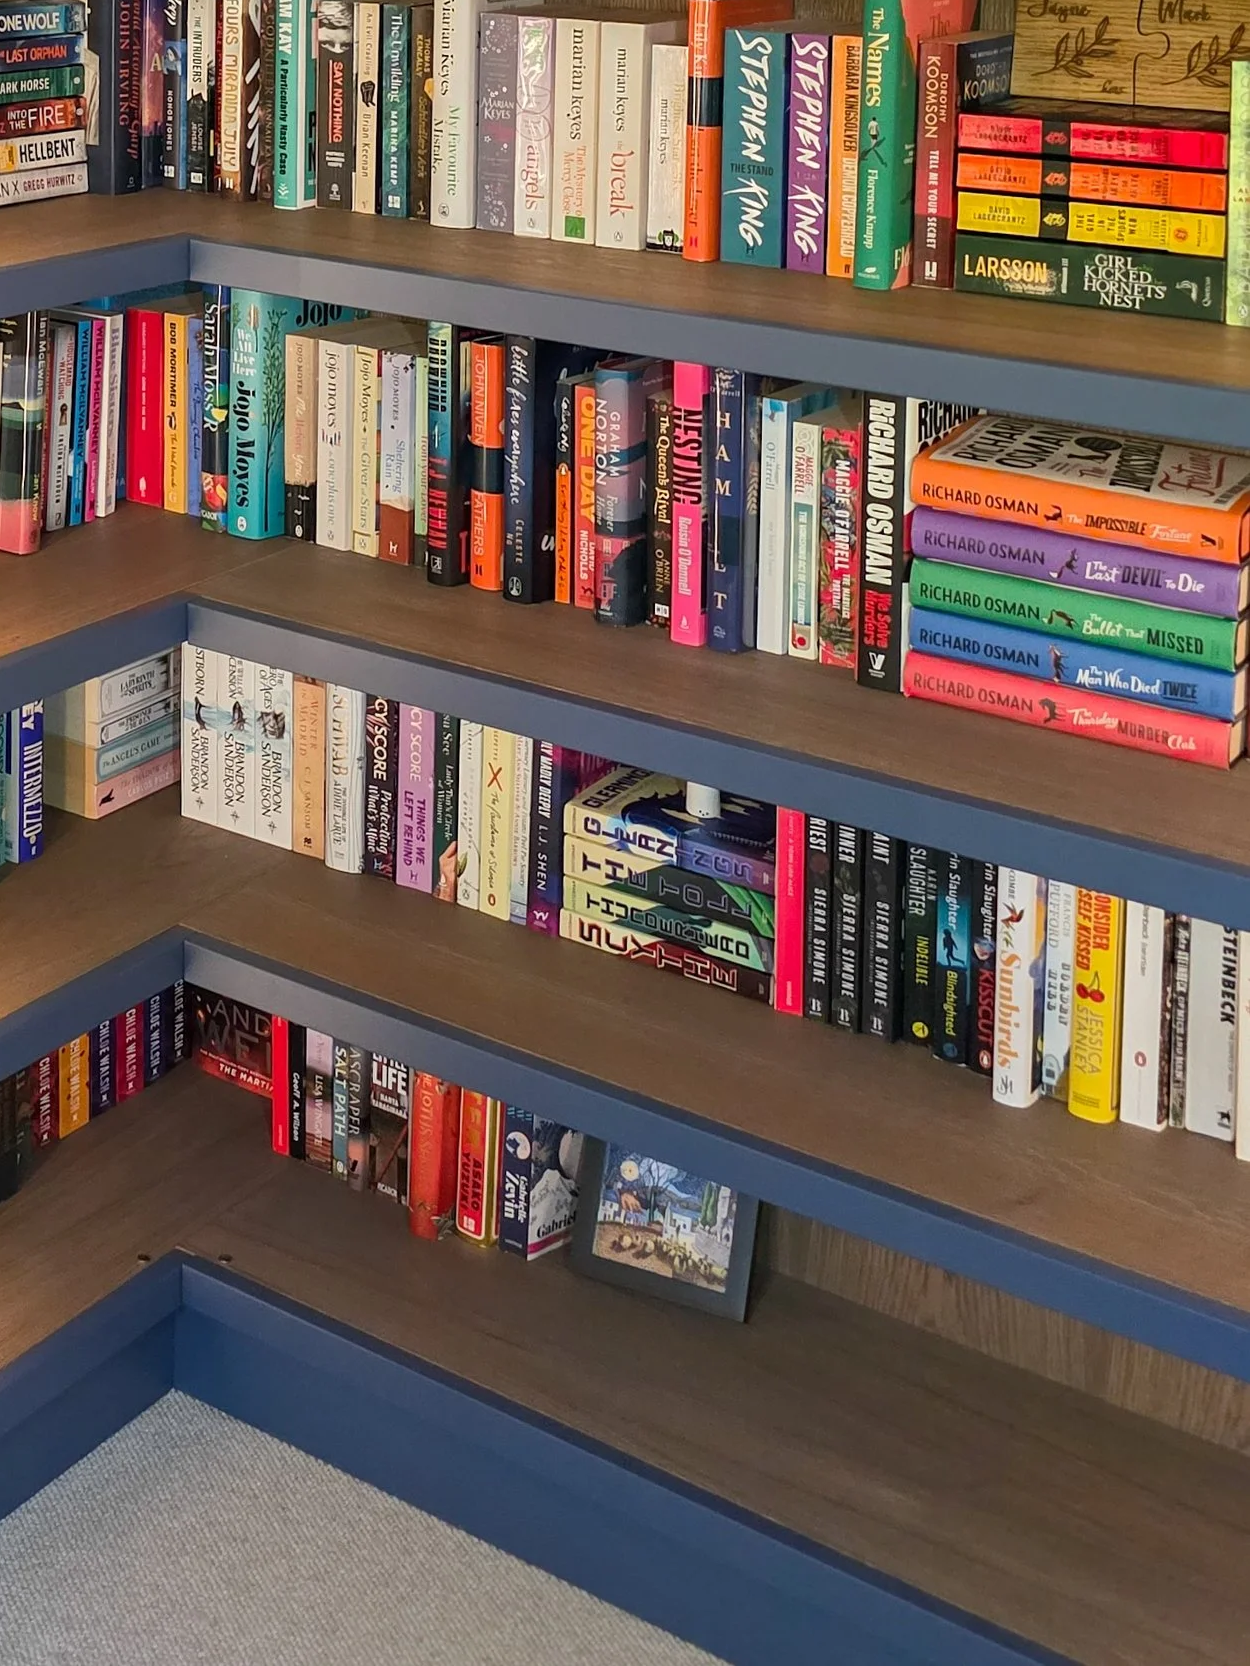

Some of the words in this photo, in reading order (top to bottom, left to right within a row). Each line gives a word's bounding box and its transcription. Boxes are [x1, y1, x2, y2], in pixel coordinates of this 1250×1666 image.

[23, 12, 61, 31] WOLF
[278, 21, 292, 55] KAY
[29, 45, 68, 61] ORPHAN
[865, 32, 890, 108] Names
[19, 77, 50, 93] HORSE
[735, 30, 773, 163] STEPHEN
[792, 34, 828, 170] STEPHEN
[924, 55, 941, 139] KOOMSON
[28, 104, 66, 128] FIRE
[332, 87, 344, 143] NOTHING
[19, 137, 76, 163] HELLBENT
[723, 177, 769, 247] KING
[788, 185, 824, 255] KING
[972, 212, 1027, 225] LAGERCRANTZ
[963, 254, 1048, 284] LARSSON
[1098, 293, 1146, 310] NEST
[581, 396, 595, 464] ONE
[595, 398, 608, 485] NORTON
[609, 411, 621, 476] GRAHAM
[674, 407, 704, 505] NESTING
[835, 457, 851, 509] MAGGIE
[985, 495, 1039, 516] OSMAN
[865, 504, 893, 585] OSMAN
[989, 544, 1045, 566] OSMAN
[984, 597, 1041, 621] OSMAN
[984, 642, 1040, 667] OSMAN
[1146, 628, 1205, 655] MISSED
[977, 688, 1034, 713] OSMAN
[191, 726, 201, 794] SANDERSON
[199, 735, 210, 791] BRANDON
[224, 731, 235, 807] SANDERSON
[234, 741, 246, 804] BRANDON
[261, 740, 273, 817] SANDERSON
[271, 750, 283, 814] BRANDON
[372, 732, 389, 781] SCORE
[22, 741, 43, 839] INTERMEZZO
[578, 919, 738, 992] SCYTHE
[915, 935, 928, 987] INDELIBLE
[1075, 922, 1092, 971] KISSED
[976, 967, 995, 1047] KISSCUT
[997, 947, 1022, 1068] Sunbirds
[1073, 1004, 1090, 1075] STANLEY
[1087, 1010, 1105, 1076] JESSICA
[292, 1107, 300, 1142] Wilson
[504, 1170, 520, 1218] Zevin
